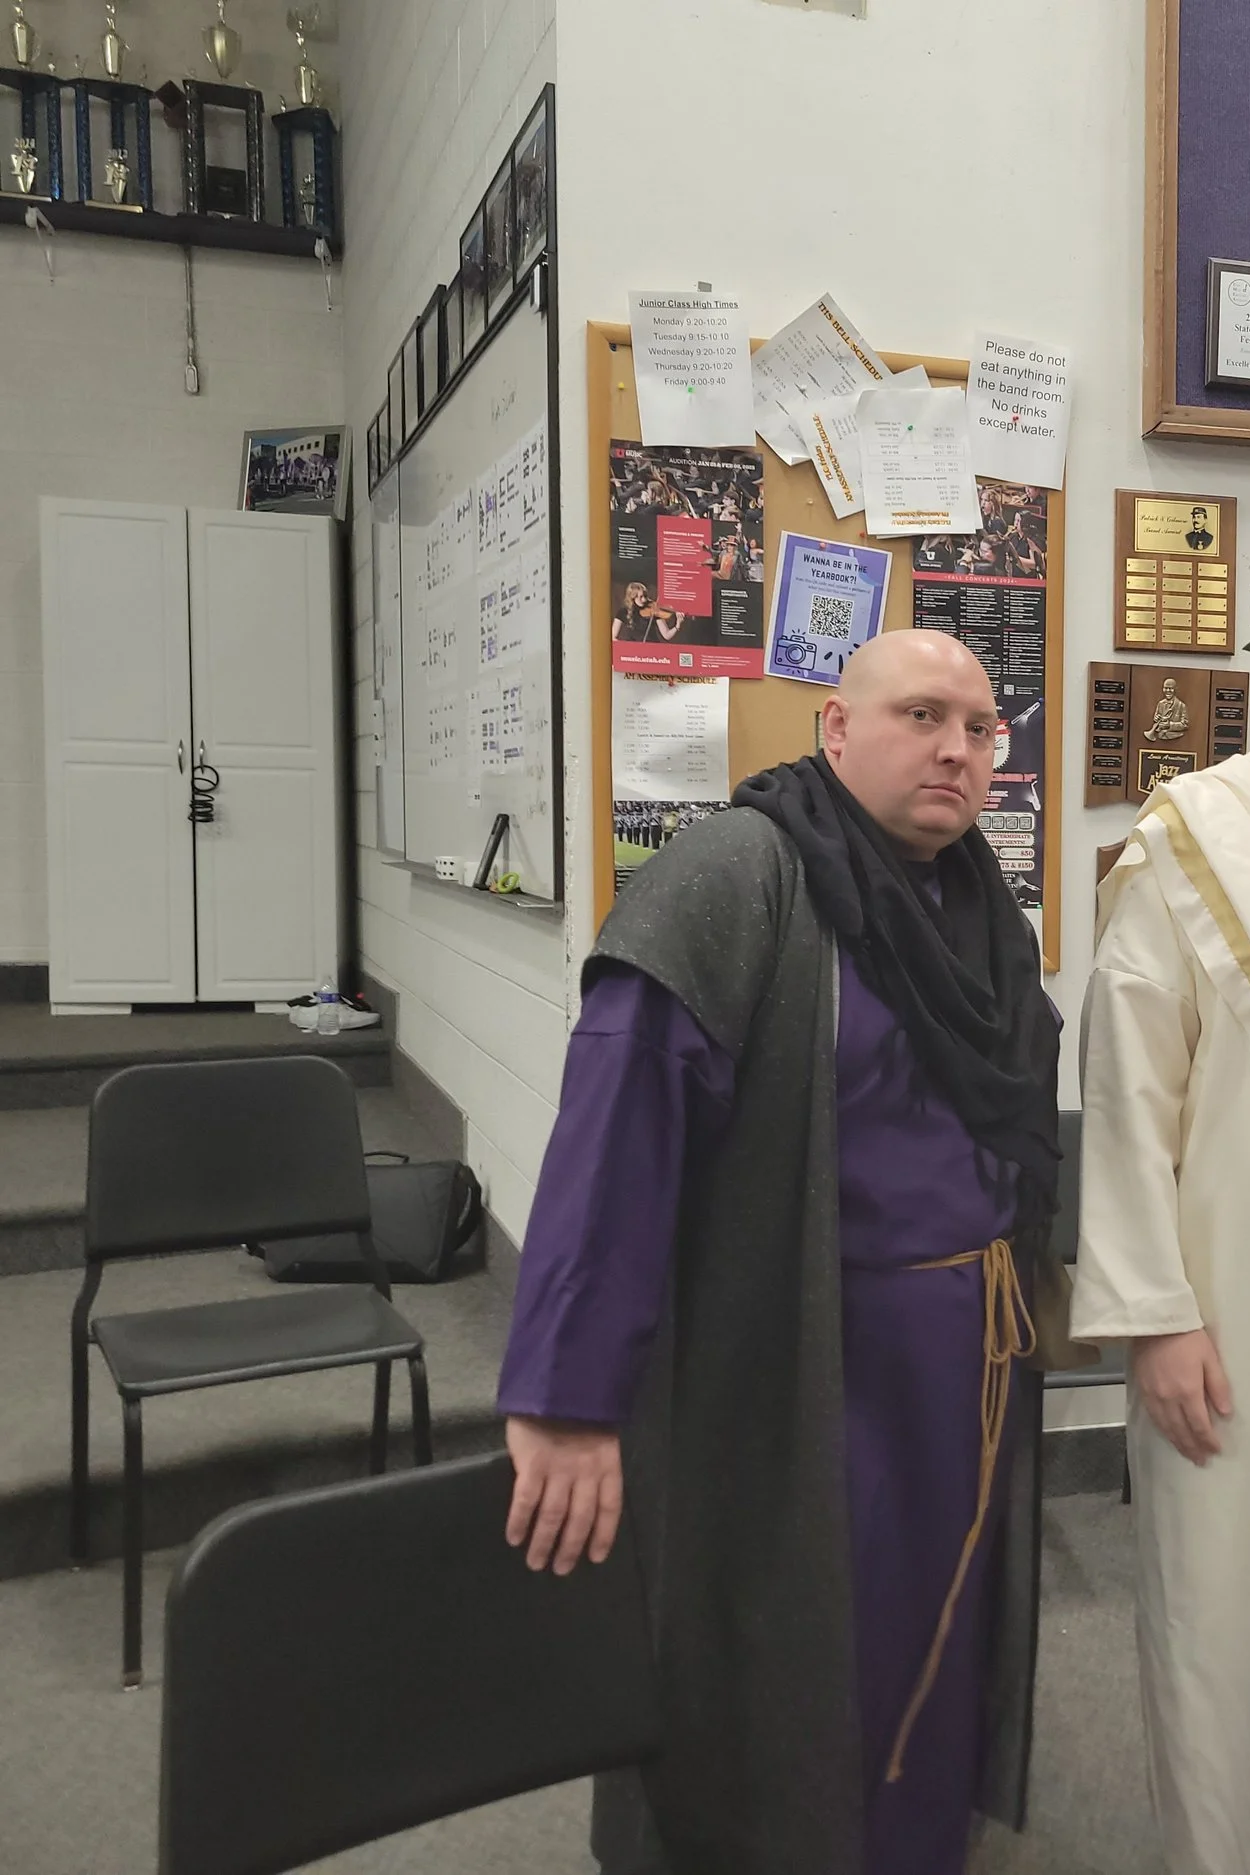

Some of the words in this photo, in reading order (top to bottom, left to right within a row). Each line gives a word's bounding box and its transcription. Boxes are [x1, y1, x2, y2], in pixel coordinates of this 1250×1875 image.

[639, 299, 665, 308] Junior
[668, 300, 691, 308] Class
[693, 300, 712, 309] High
[714, 301, 739, 309] Times
[653, 317, 684, 327] Monday
[653, 333, 686, 342] Tuesday
[817, 301, 834, 321] THS
[832, 320, 851, 345] BELL
[850, 343, 883, 381] SCHEDU
[648, 348, 694, 357] Wednesday
[986, 341, 1025, 359] Please
[1029, 351, 1043, 362] do
[1047, 356, 1065, 367] not
[655, 362, 690, 372] Thursday
[981, 361, 999, 373] eat
[1003, 366, 1052, 385] anything
[1055, 373, 1066, 385] in
[665, 378, 688, 386] Friday
[977, 377, 995, 390] the
[999, 381, 1028, 397] band
[1032, 389, 1065, 403] room.
[991, 398, 1008, 411] No
[1012, 403, 1047, 418] drinks
[979, 416, 1017, 433] except
[1021, 424, 1055, 438] water.
[669, 458, 697, 466] AUDITION
[816, 445, 827, 465] Friday
[803, 553, 831, 567] WANNA
[833, 559, 842, 569] BE
[844, 561, 852, 570] IN
[854, 563, 868, 574] THE
[811, 568, 857, 585] YEARBOOK?!
[621, 655, 671, 664] music.utah.edu
[1156, 764, 1180, 778] Jazz
